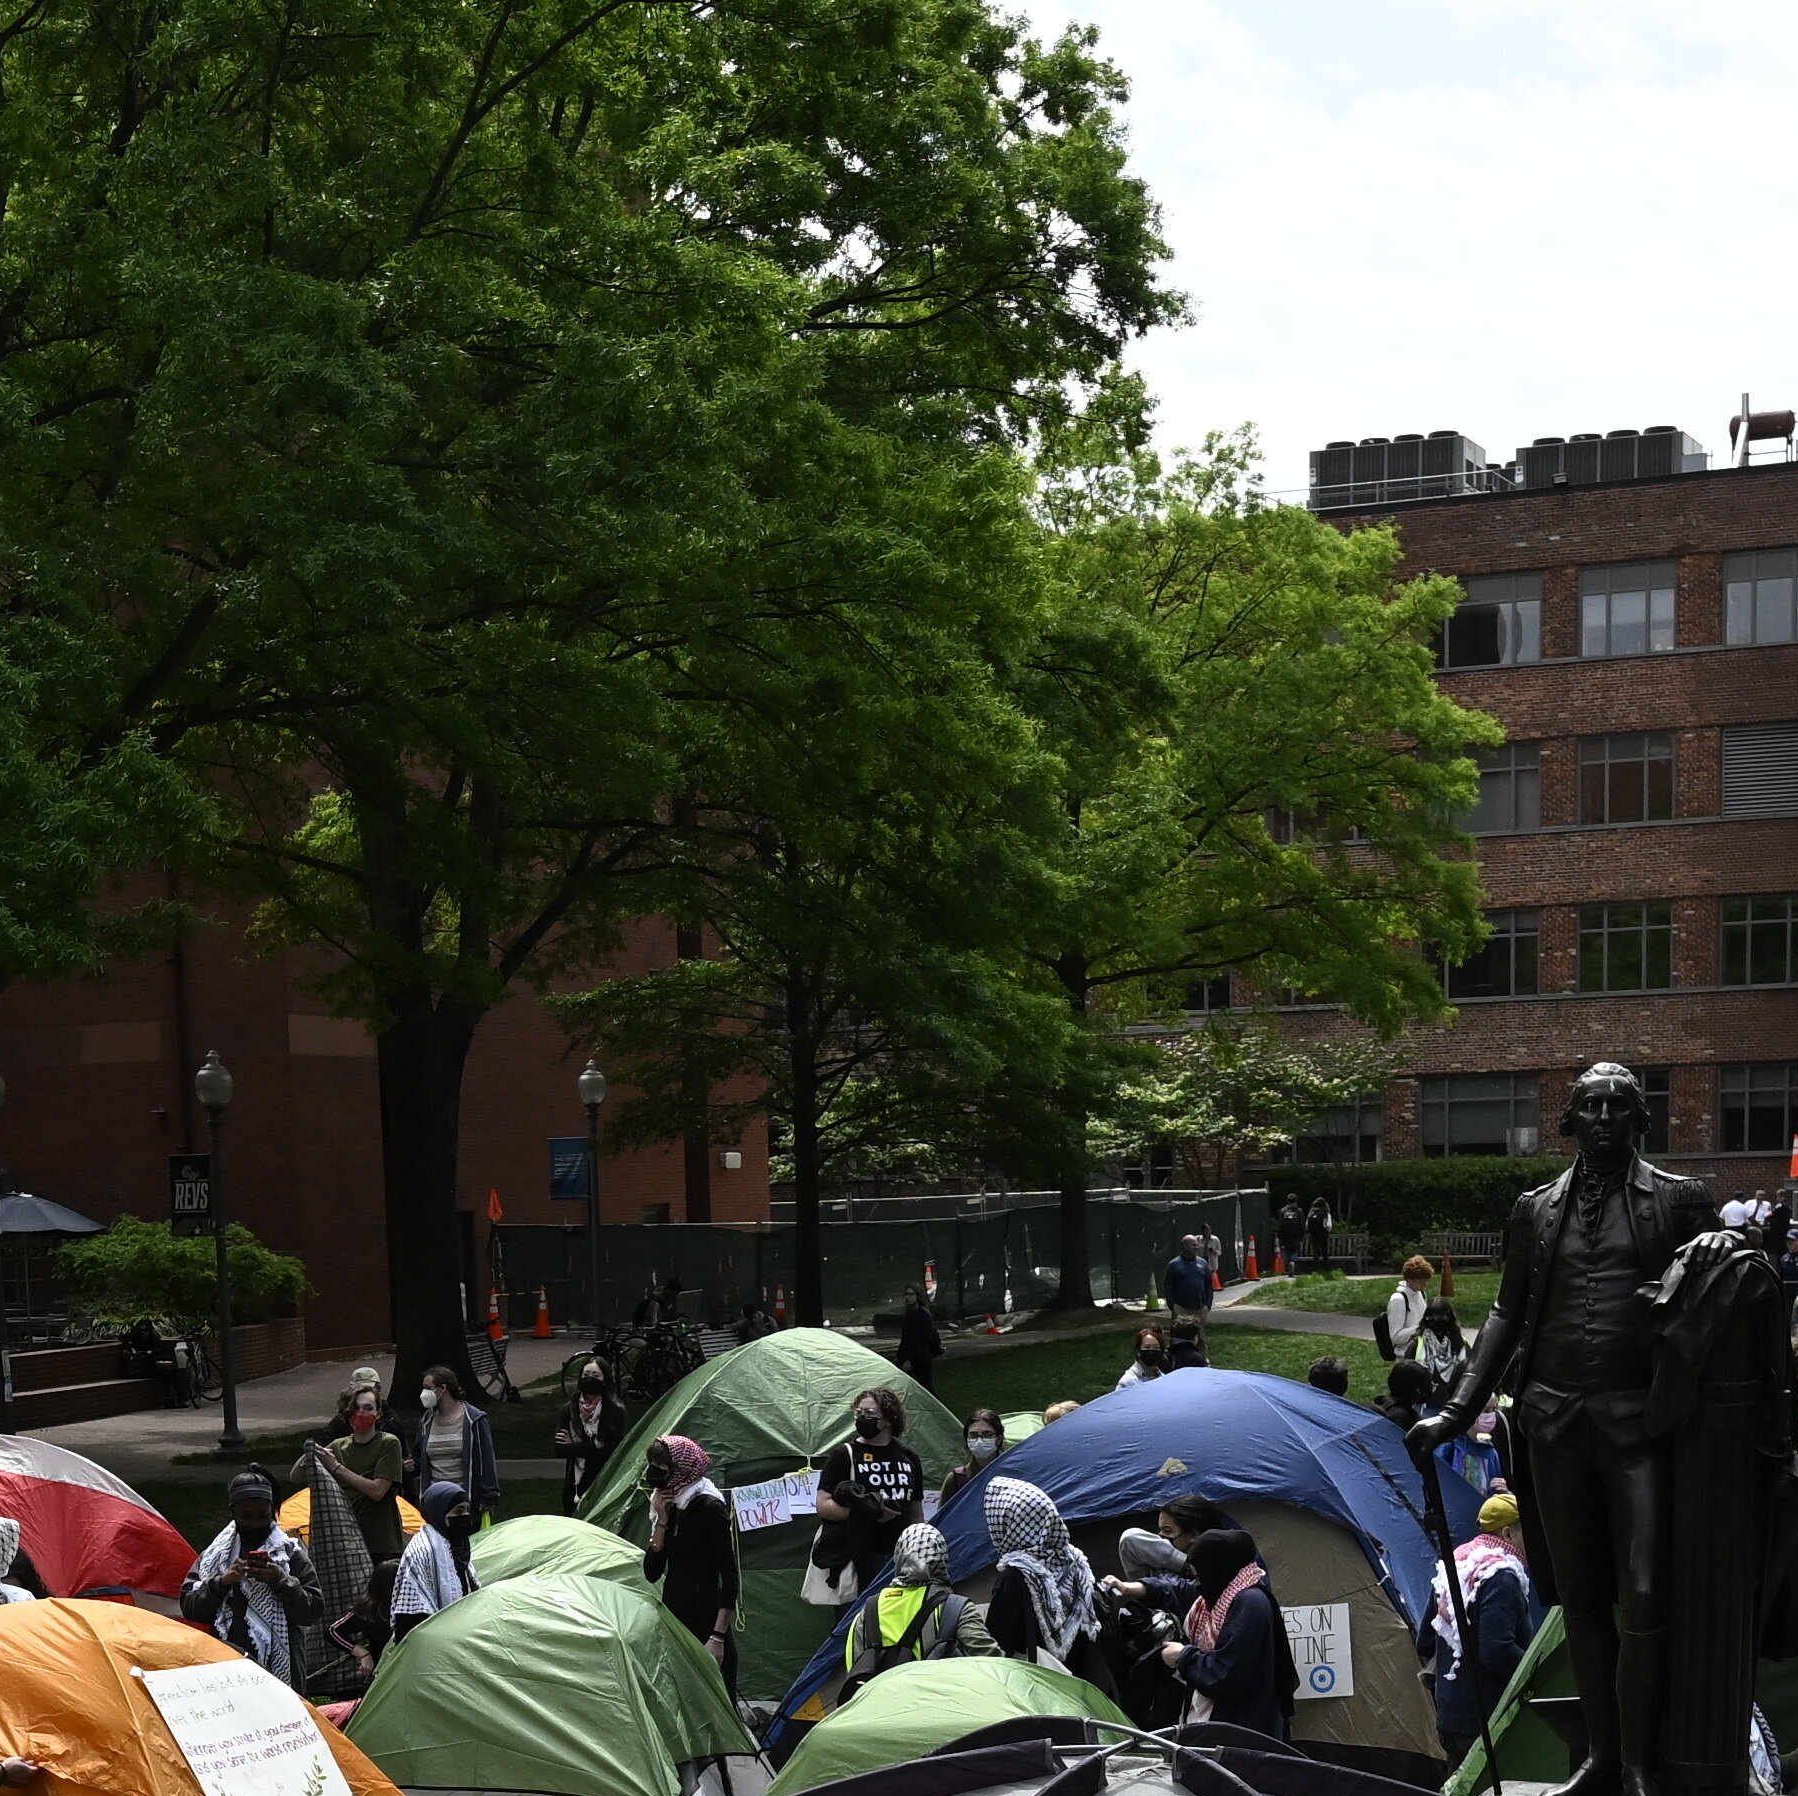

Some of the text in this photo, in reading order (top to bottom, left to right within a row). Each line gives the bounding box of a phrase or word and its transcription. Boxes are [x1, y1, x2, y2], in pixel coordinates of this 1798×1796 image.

[174, 1182, 209, 1210] REVS
[858, 1461, 912, 1474] NOT IN
[869, 1473, 909, 1486] OUR
[879, 1487, 914, 1502] AME
[739, 1498, 787, 1530] POWER
[1280, 1605, 1332, 1634] ES ON
[1288, 1633, 1336, 1666] TINE
